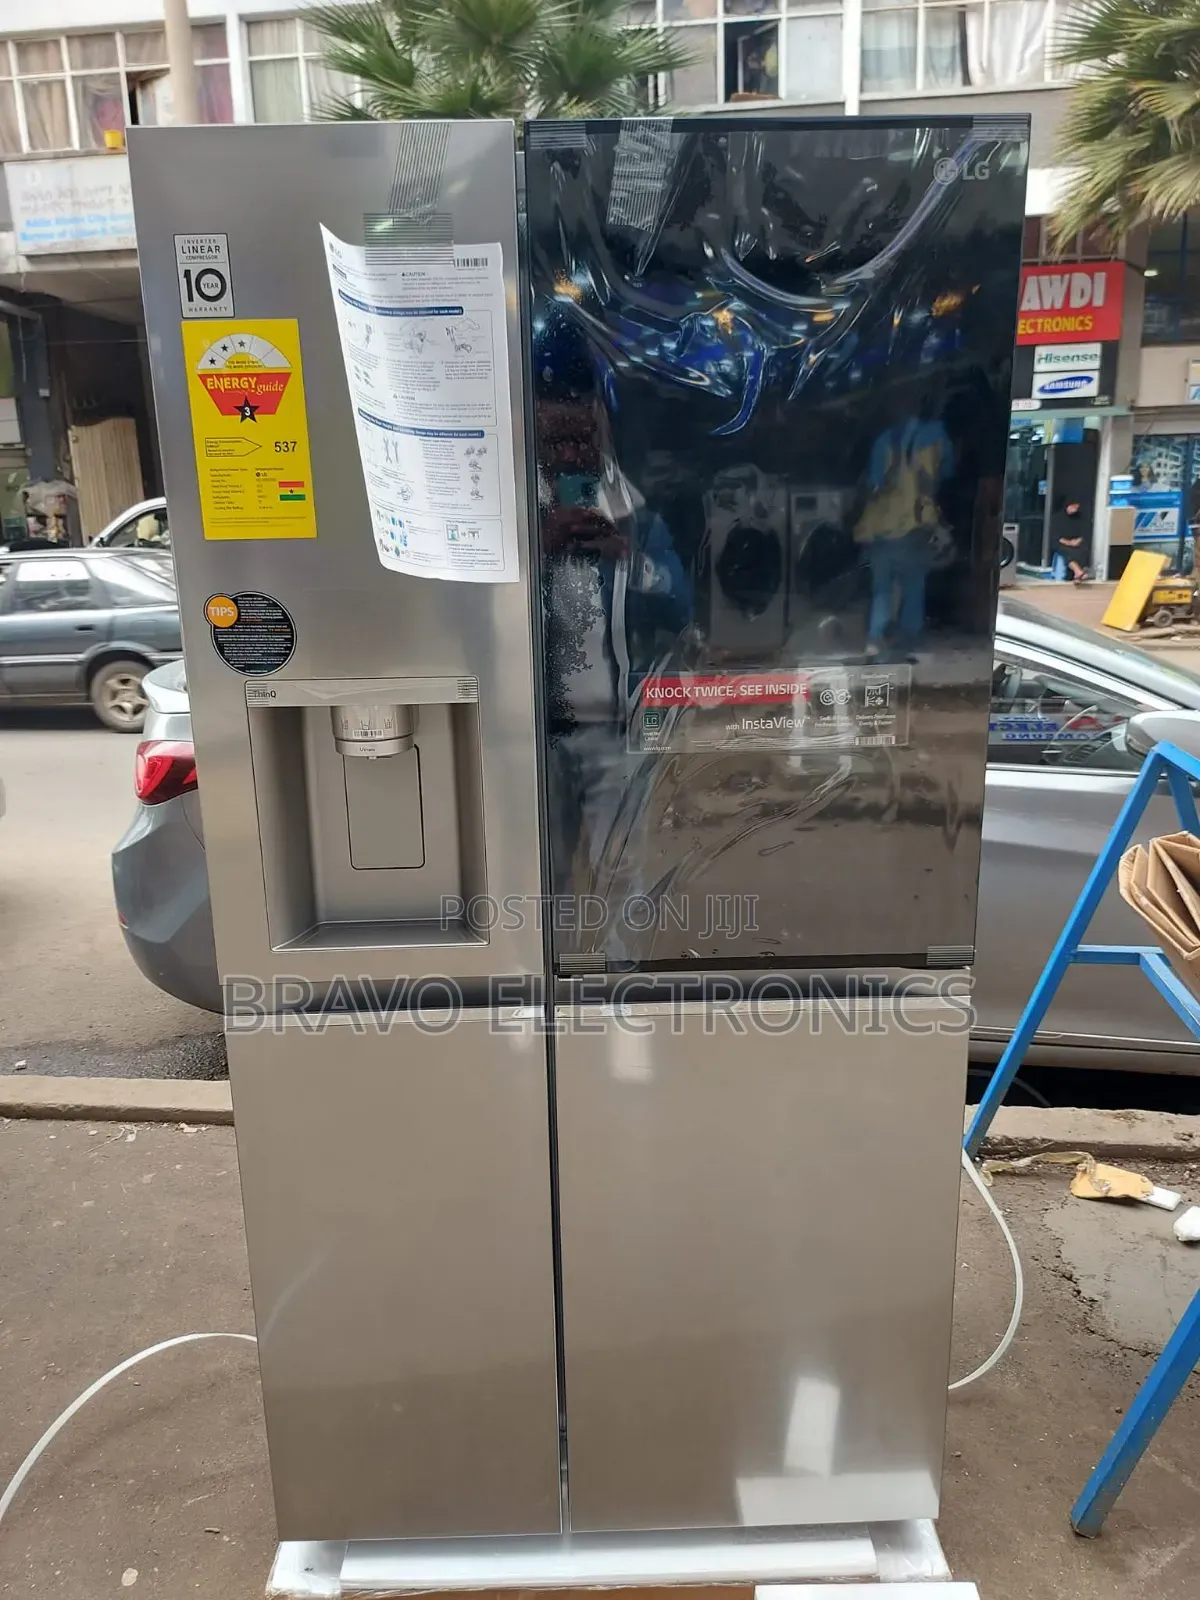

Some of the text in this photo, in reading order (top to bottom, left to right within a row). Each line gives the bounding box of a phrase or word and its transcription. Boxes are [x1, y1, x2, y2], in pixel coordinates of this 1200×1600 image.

[962, 161, 989, 180] LG
[181, 245, 221, 254] LINEAR
[184, 267, 227, 302] 10
[1020, 272, 1106, 311] AWDI
[1017, 315, 1094, 335] ECTRONICS
[1037, 353, 1100, 364] Hisense
[206, 374, 284, 395] ENERGY guide
[1043, 378, 1088, 390] SAMSUNG
[244, 407, 251, 416] 3
[274, 441, 297, 453] 537
[208, 606, 235, 617] TIPS
[646, 683, 807, 698] KNOCK TWICE, SEE INSIDE
[725, 723, 740, 731] with
